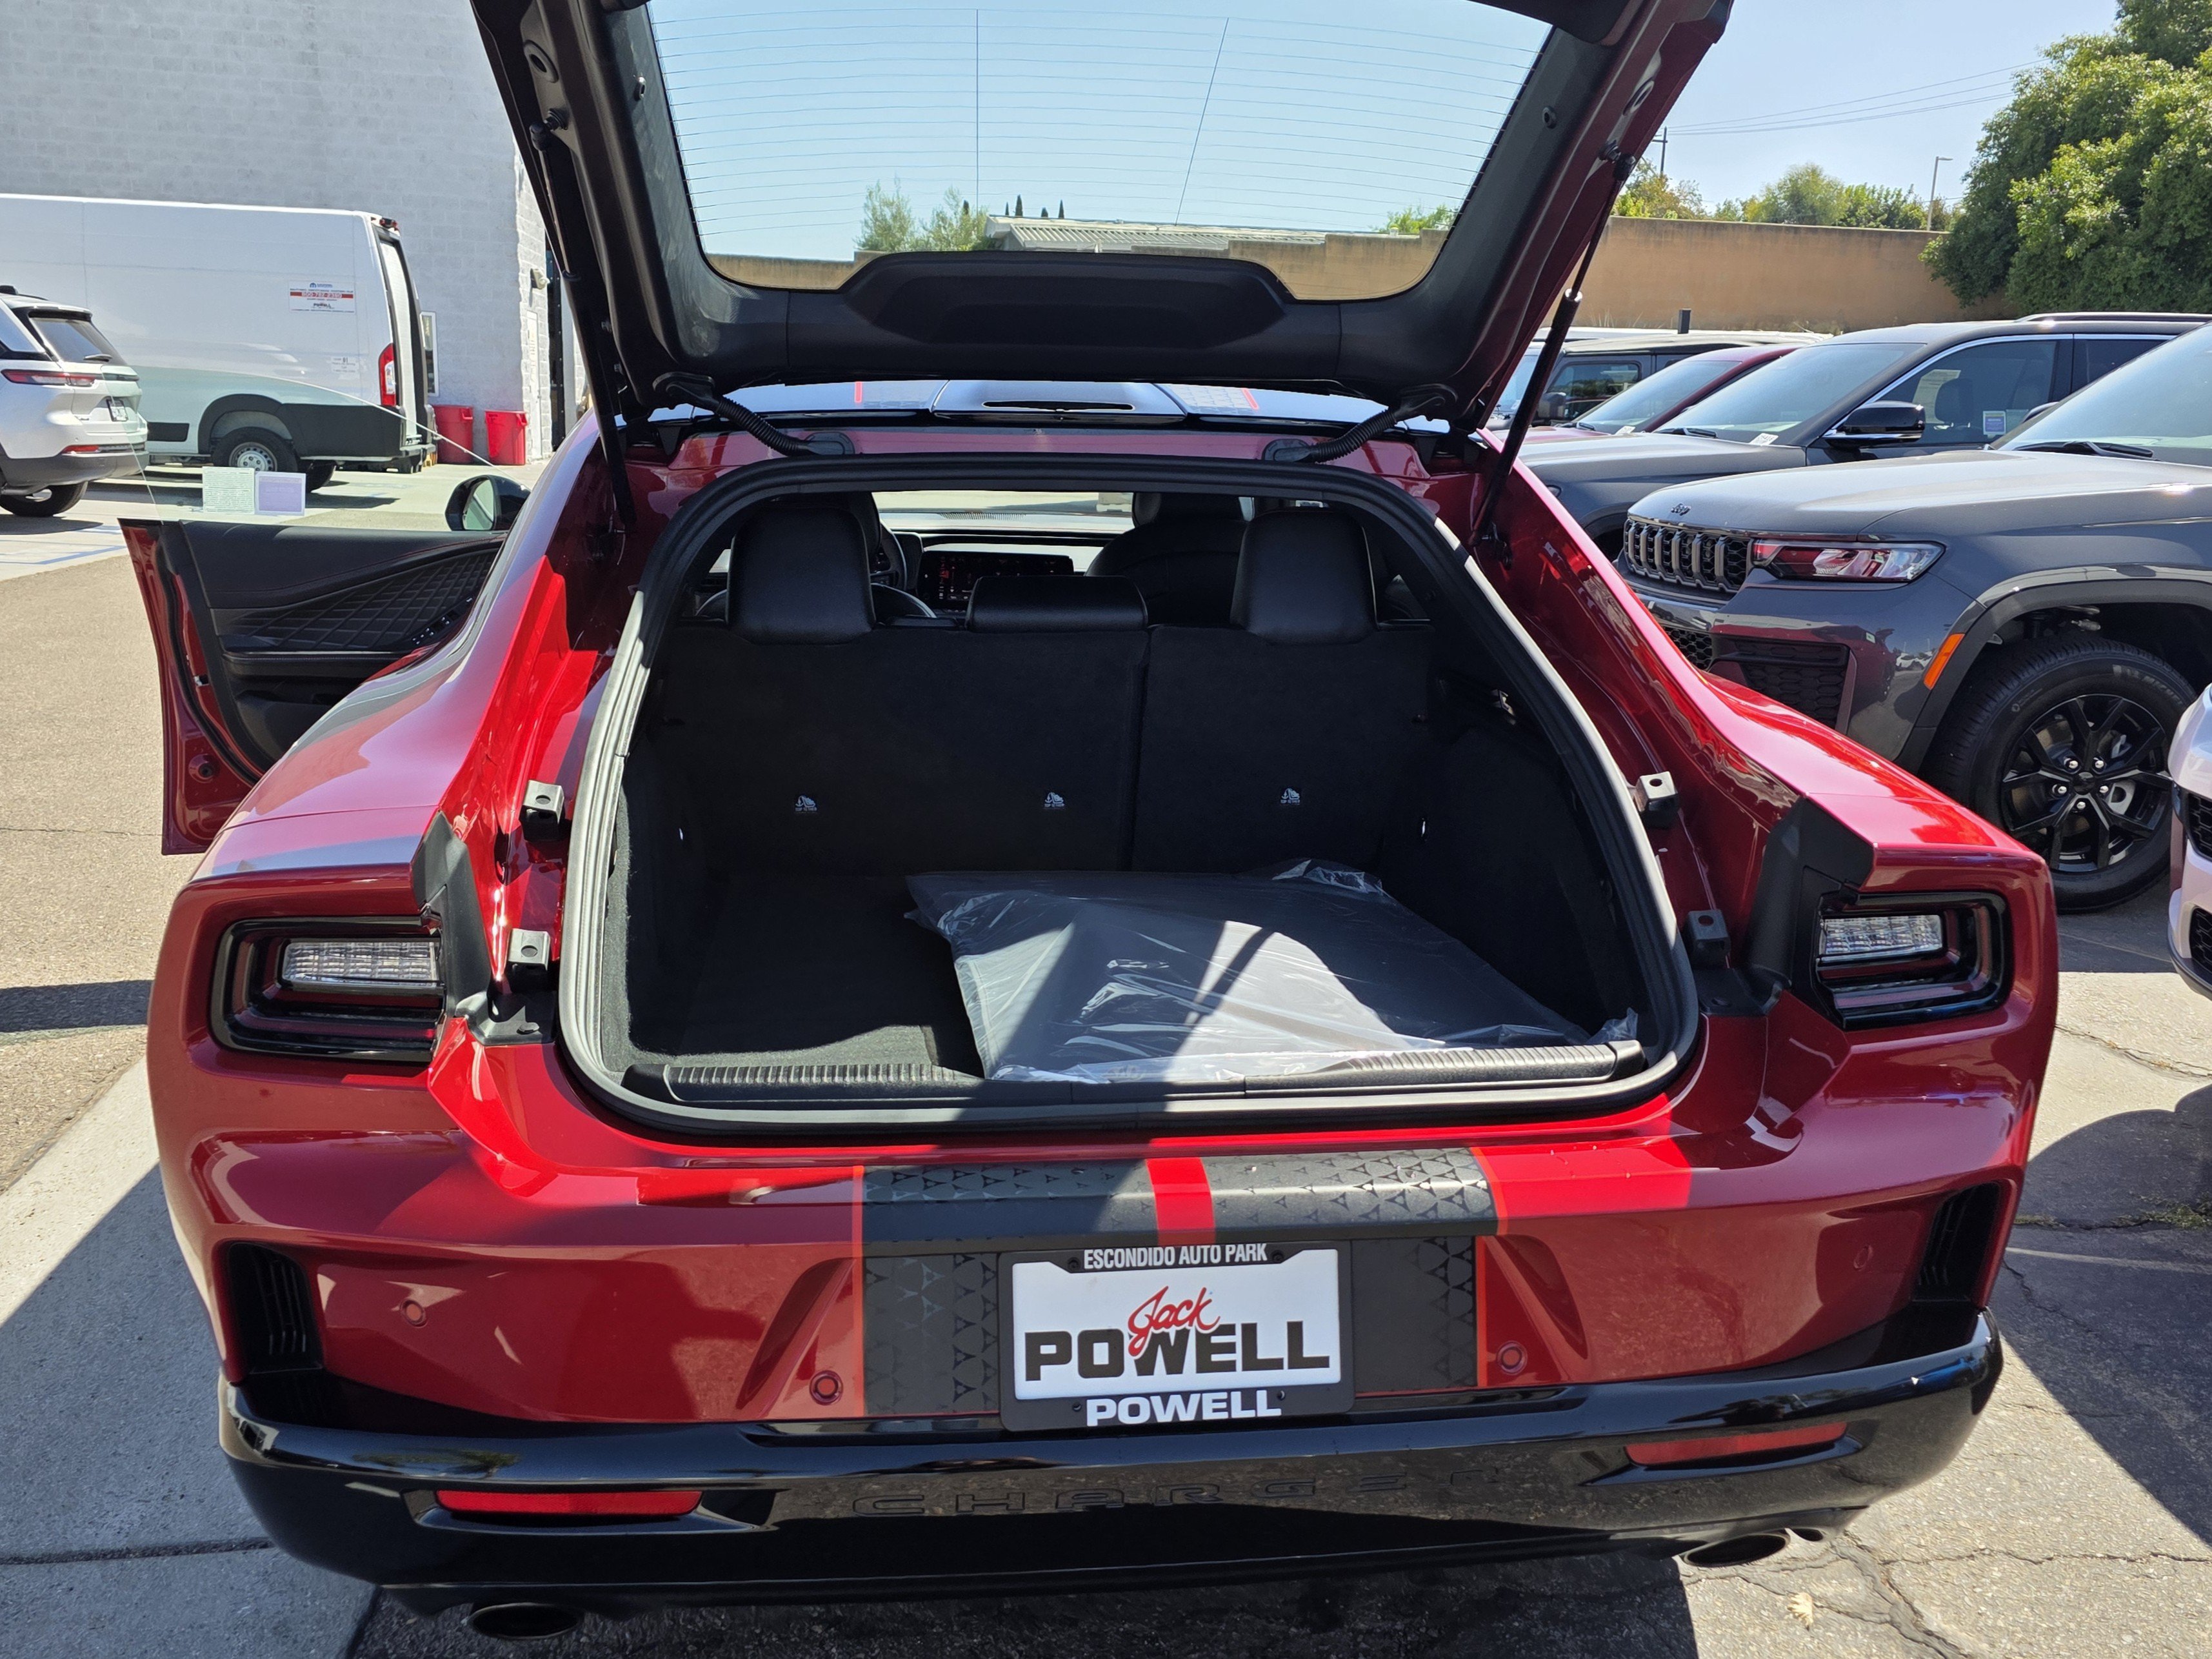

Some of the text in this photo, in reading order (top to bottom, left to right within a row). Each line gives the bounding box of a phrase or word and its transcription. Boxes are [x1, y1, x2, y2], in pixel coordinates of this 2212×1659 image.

[1084, 1243, 1268, 1269] ESCONDIDO AUTO PARK
[1128, 1285, 1221, 1357] Jack
[1024, 1321, 1330, 1382] POWELL
[1086, 1389, 1282, 1427] POWELL
